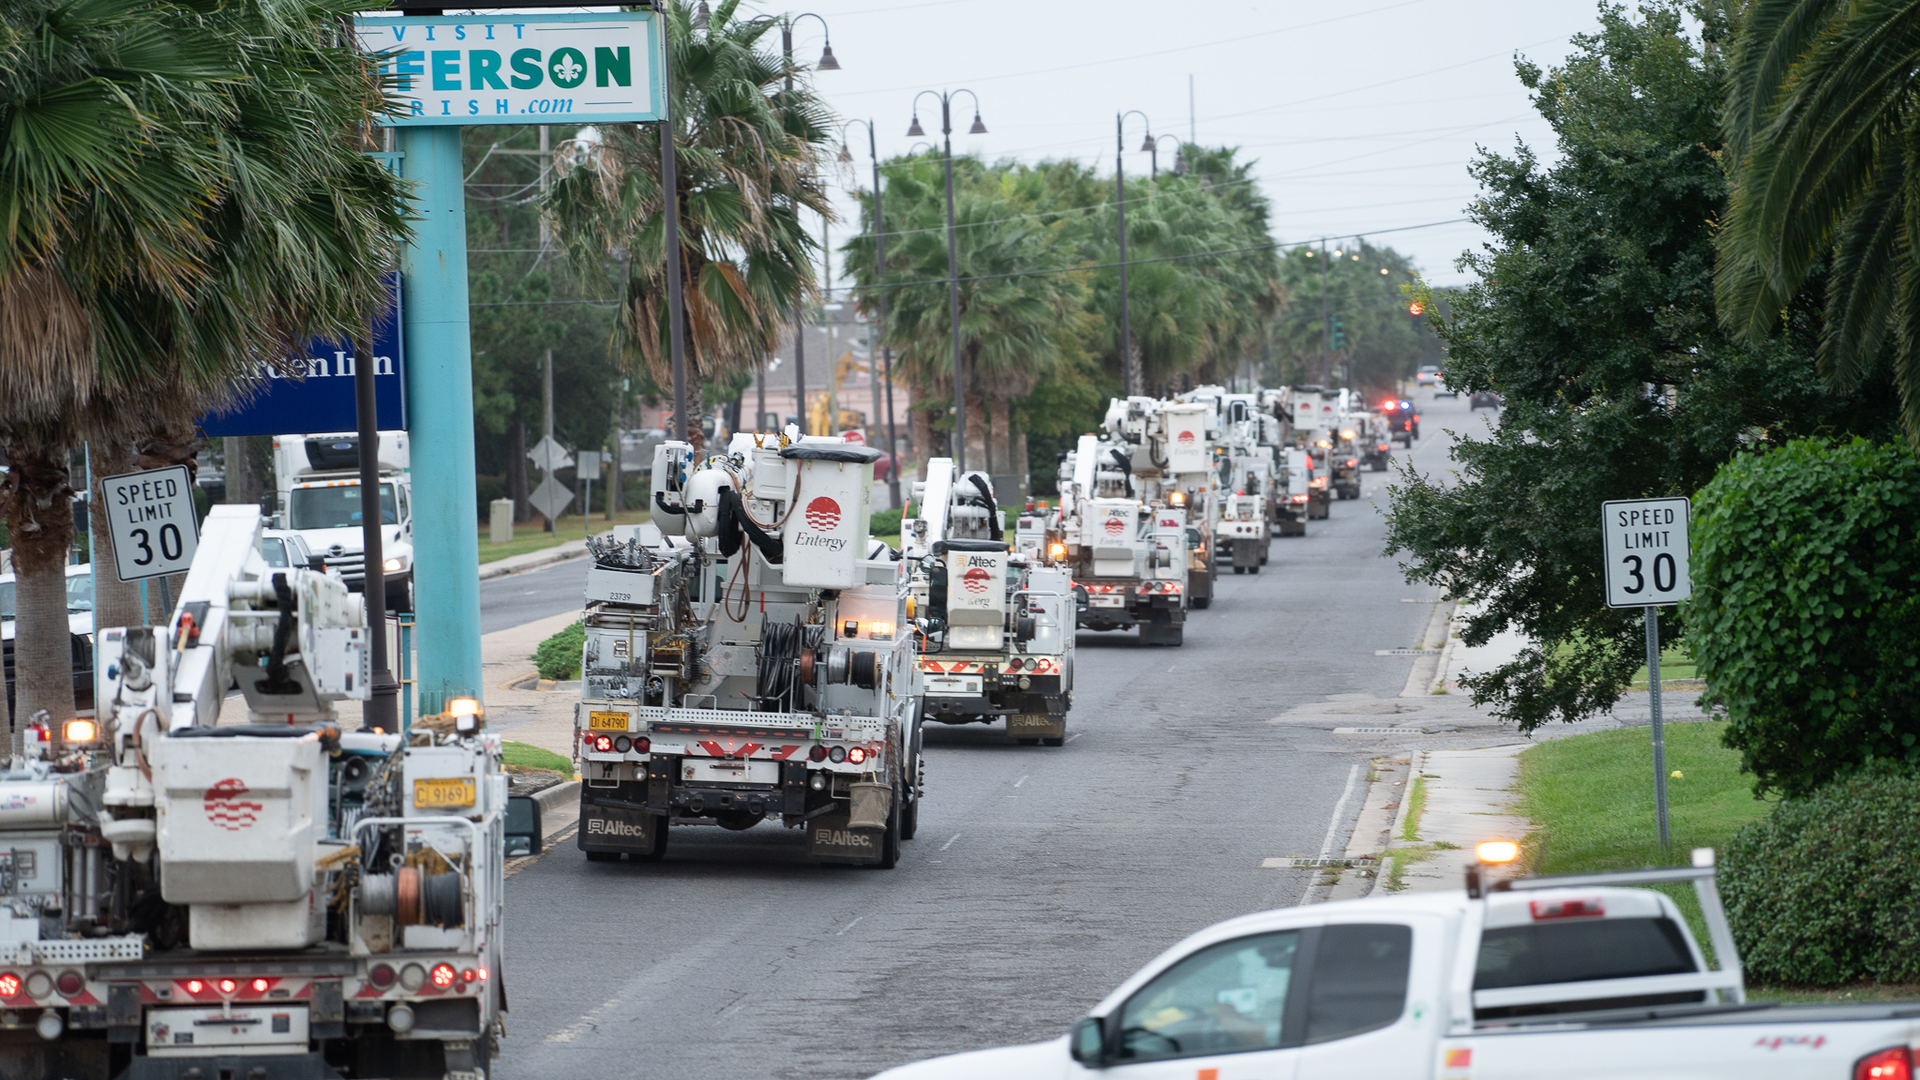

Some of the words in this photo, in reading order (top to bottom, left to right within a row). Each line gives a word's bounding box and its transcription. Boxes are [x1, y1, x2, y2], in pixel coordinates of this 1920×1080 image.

[392, 24, 525, 41] VISIT
[364, 46, 631, 92] FERSON
[117, 479, 177, 505] SPEED
[128, 502, 172, 524] LIMIT
[1618, 508, 1674, 527] SPEED
[130, 523, 183, 566] 30
[795, 531, 847, 552] Entergy
[1625, 531, 1670, 549] LIMIT
[967, 555, 997, 568] Altec
[1622, 552, 1677, 594] 30
[609, 592, 631, 601] 23739
[601, 717, 625, 729] 64790
[433, 786, 468, 802] 91691
[603, 820, 643, 837] Altec
[831, 830, 870, 847] Altec
